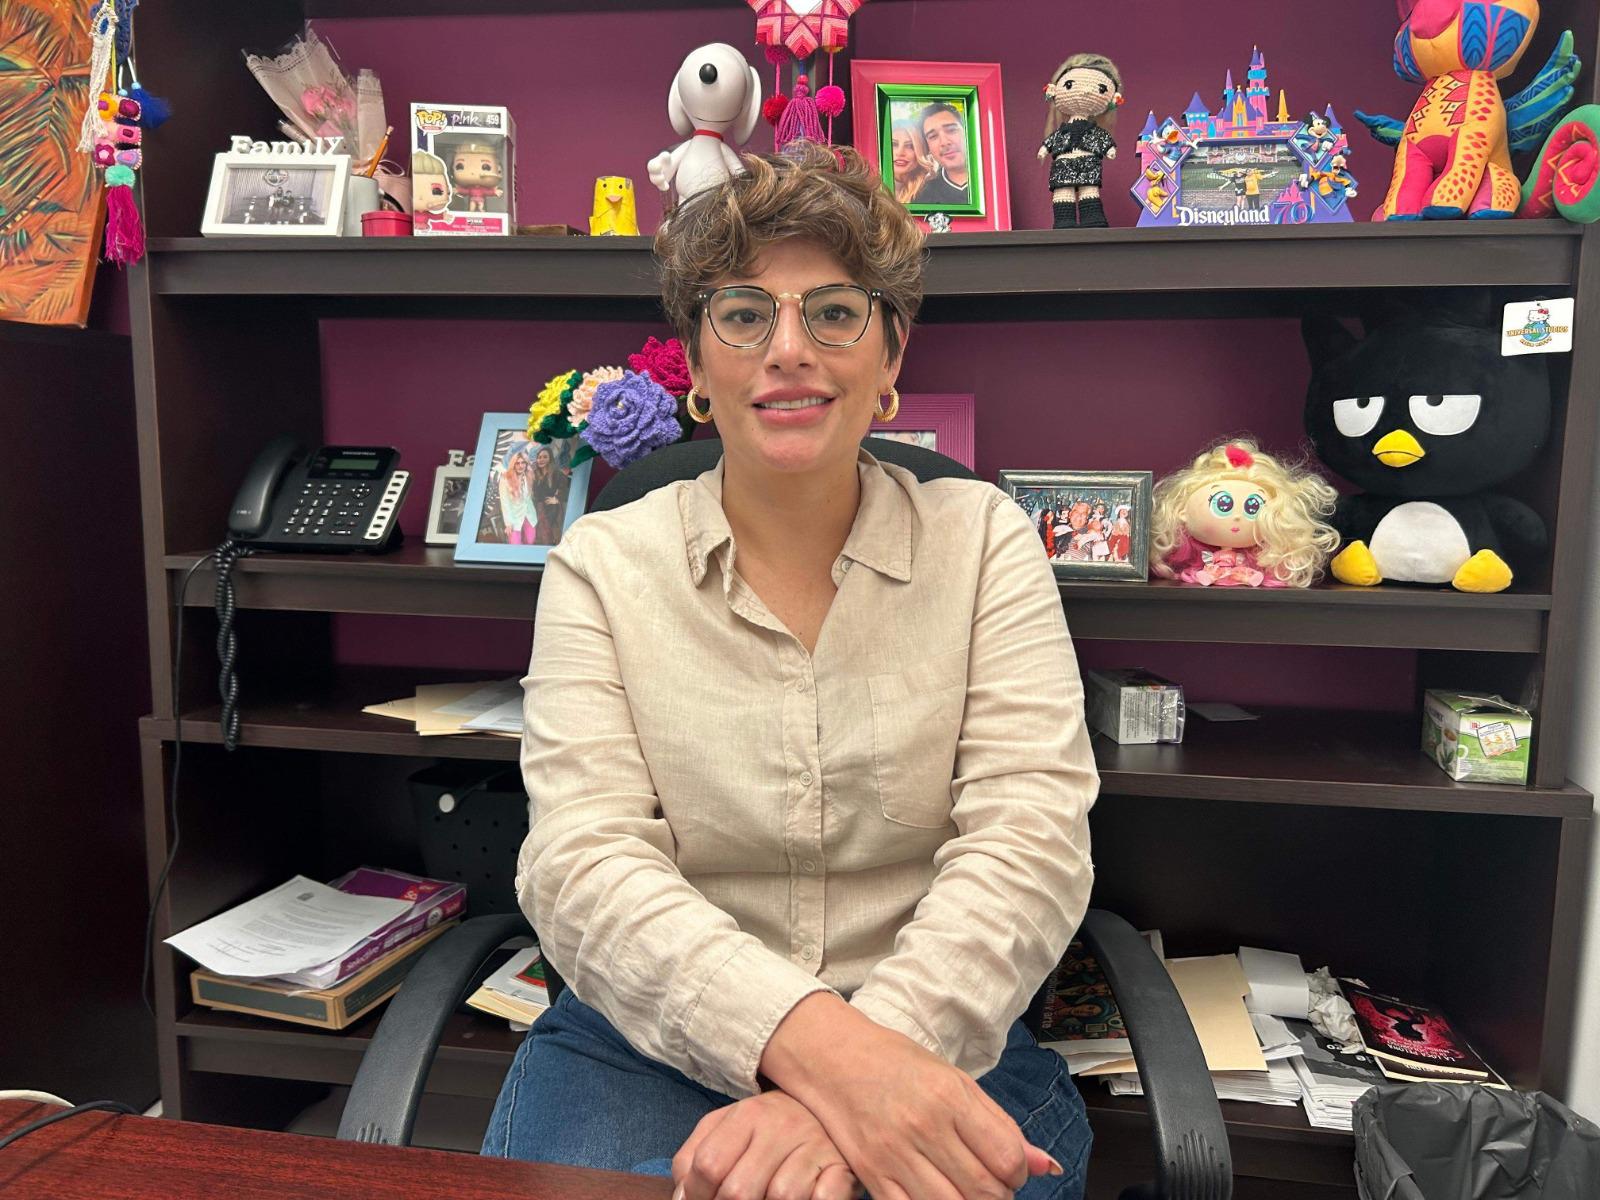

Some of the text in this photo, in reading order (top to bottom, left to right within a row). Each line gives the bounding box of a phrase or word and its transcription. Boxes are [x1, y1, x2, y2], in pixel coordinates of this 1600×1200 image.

[416, 109, 447, 126] POP!
[486, 113, 500, 125] 459
[1176, 204, 1270, 226] Disneyland
[1506, 326, 1569, 337] UNIVERSAL STUDIOS
[1042, 1012, 1053, 1029] arte
